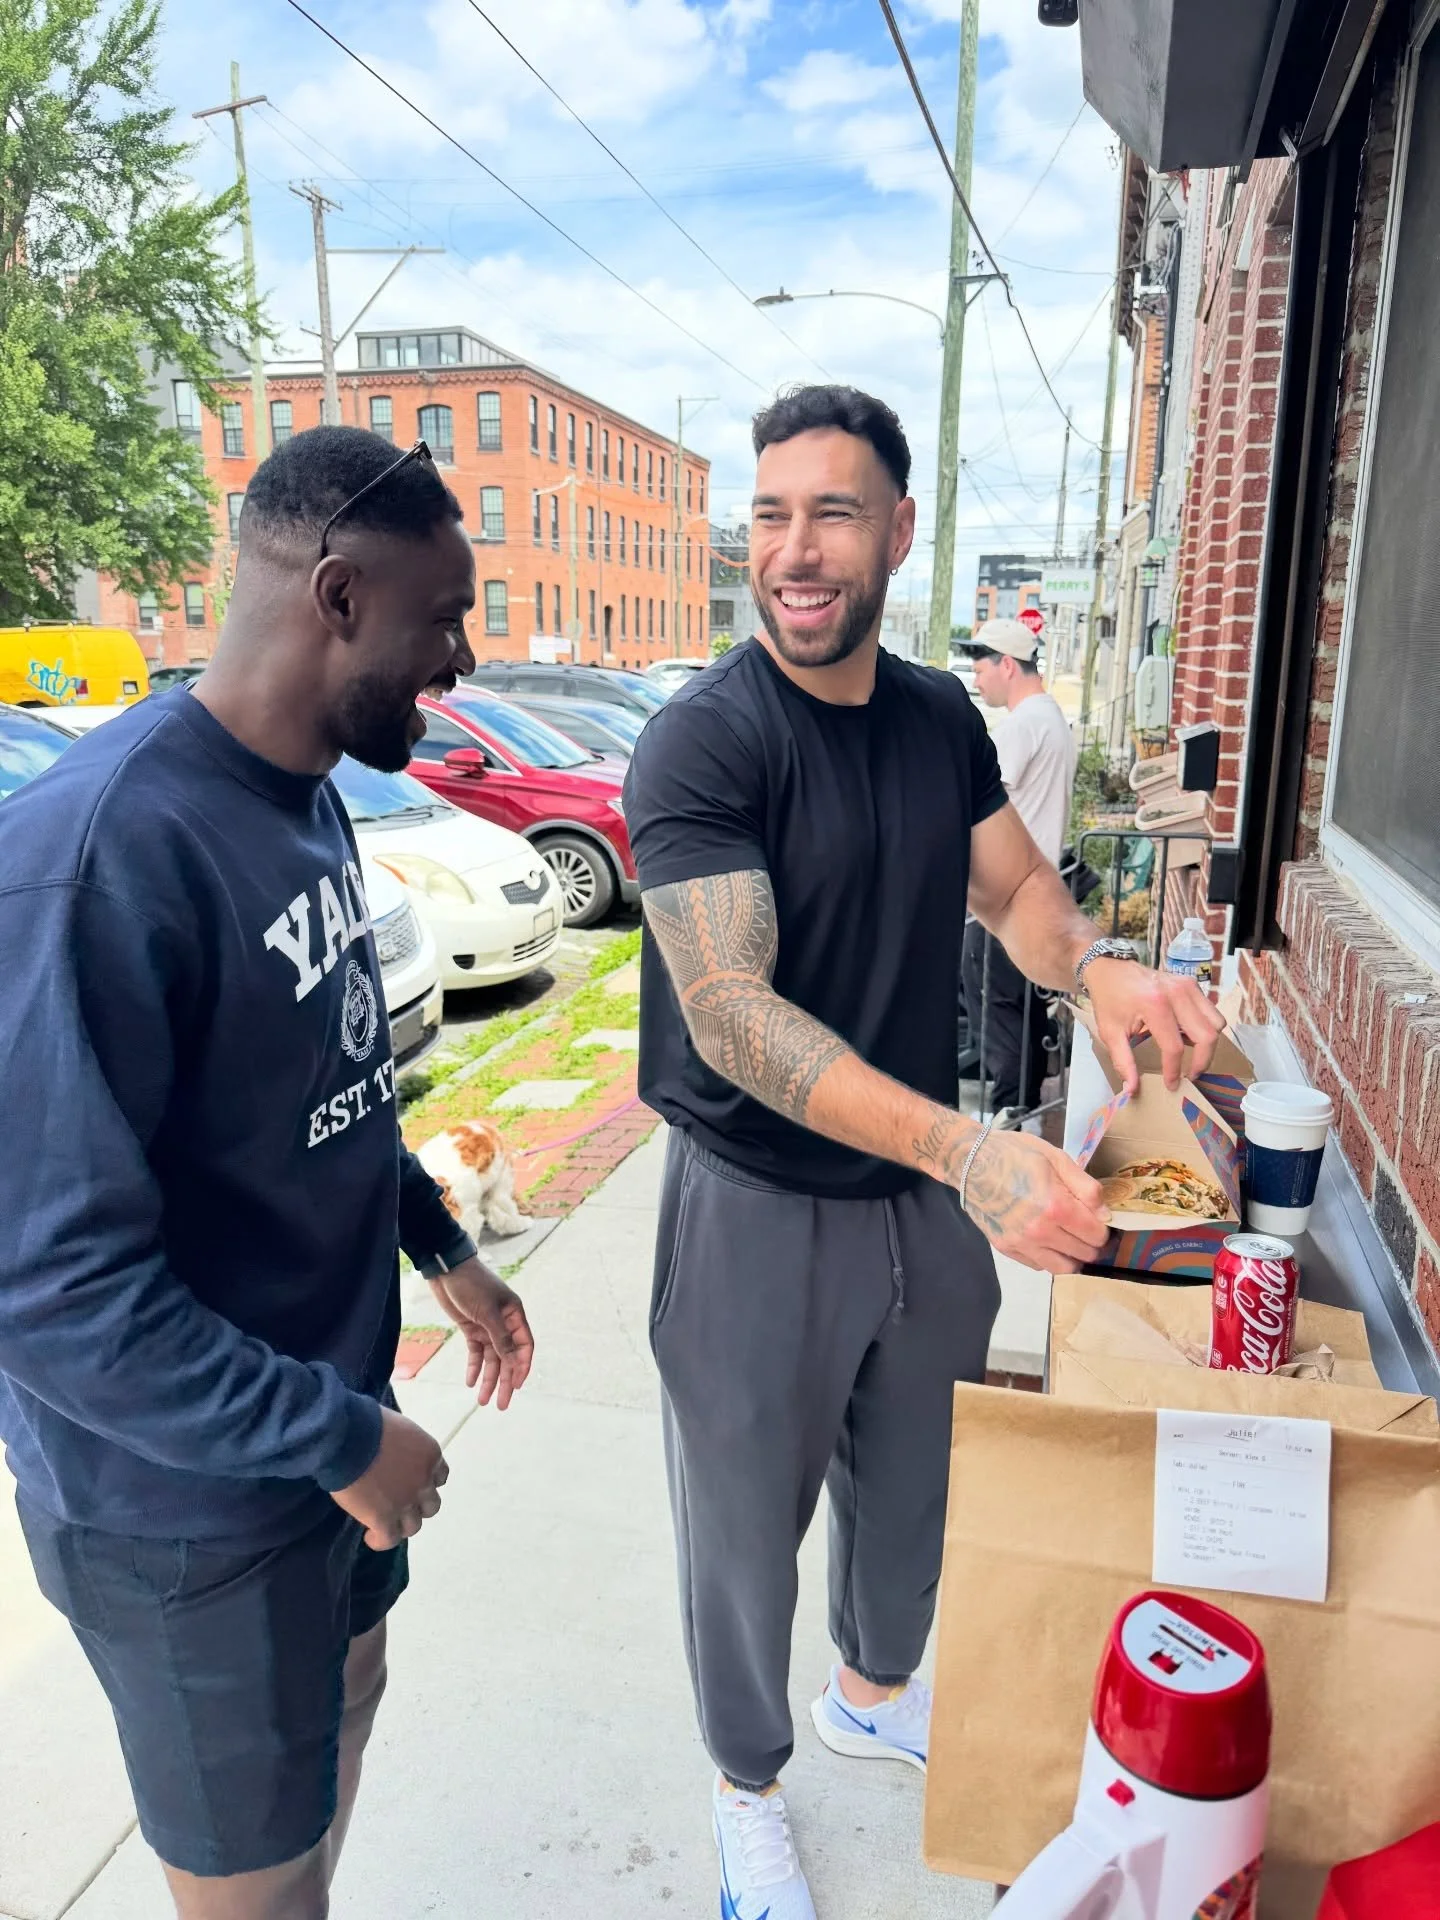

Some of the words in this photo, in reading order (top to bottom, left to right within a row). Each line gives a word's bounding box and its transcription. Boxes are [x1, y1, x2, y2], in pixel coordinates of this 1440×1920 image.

[1046, 580, 1089, 591] PERRY'S
[308, 1079, 371, 1148] EST.
[1176, 1621, 1215, 1648] VOLUME
